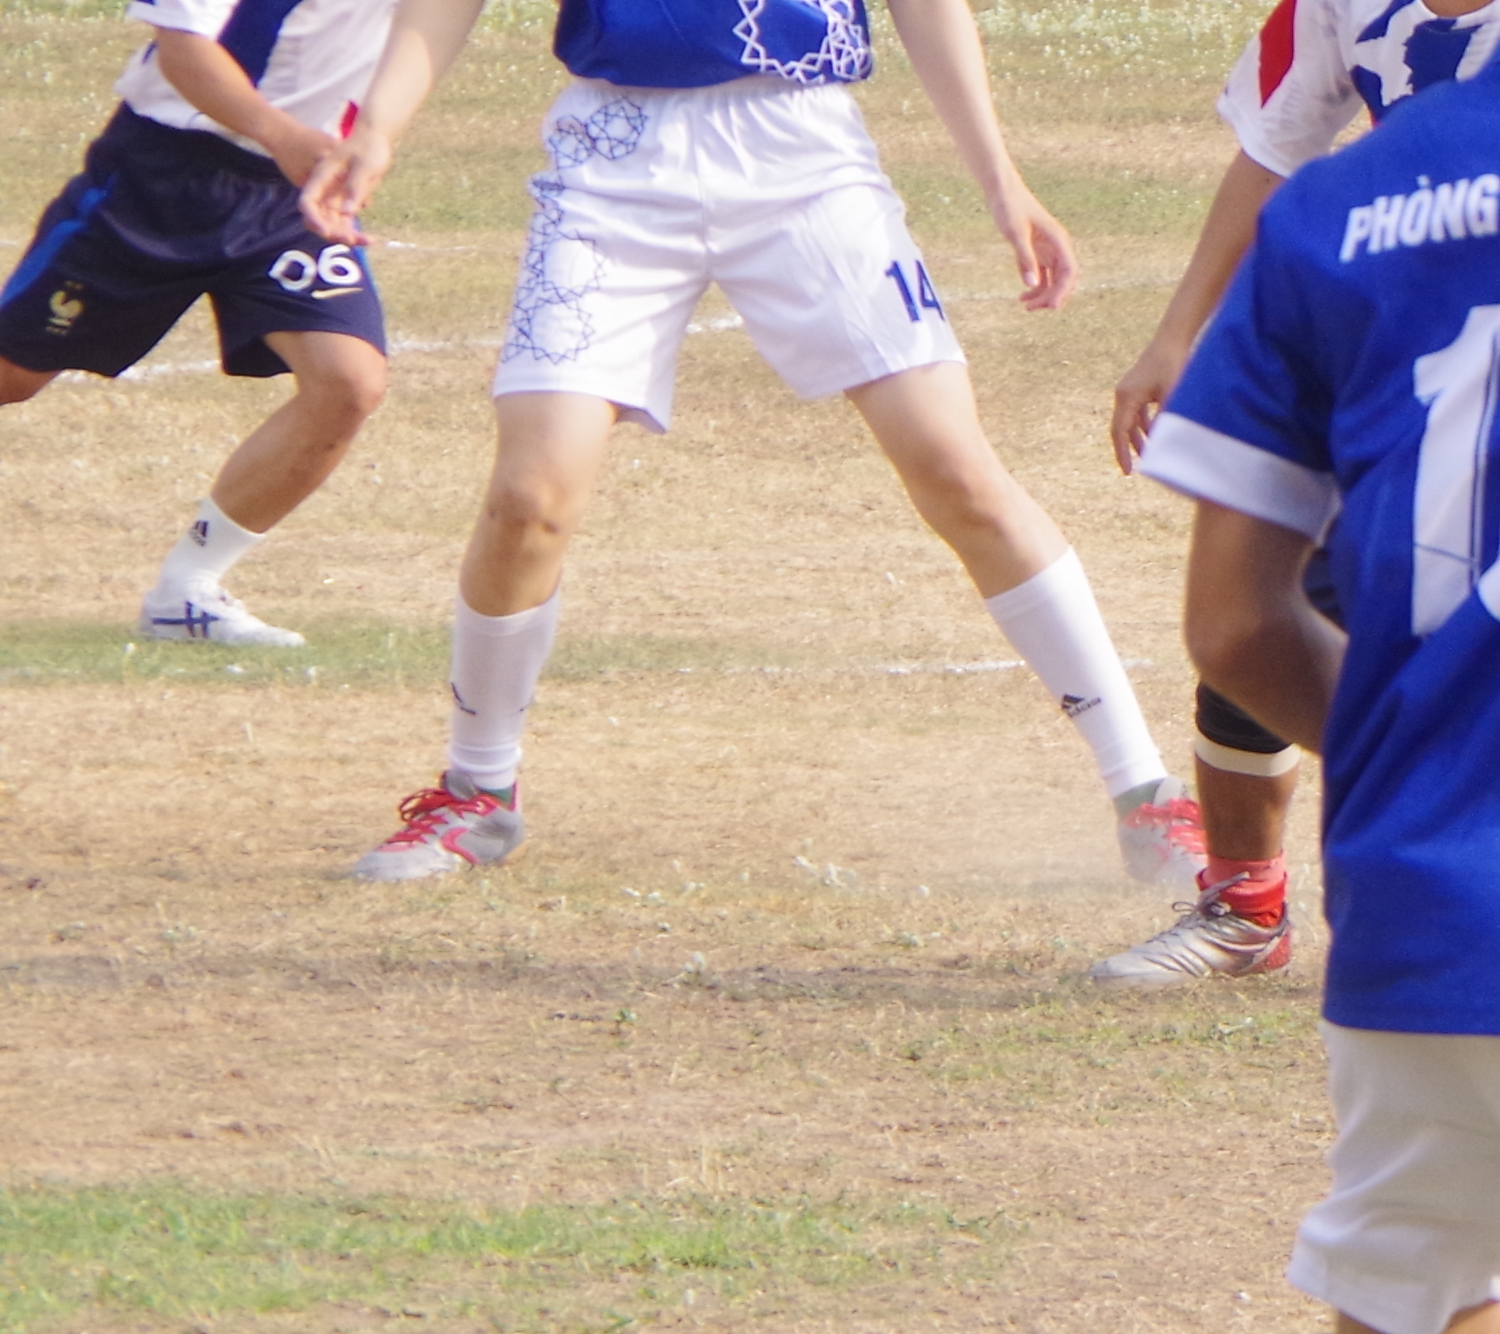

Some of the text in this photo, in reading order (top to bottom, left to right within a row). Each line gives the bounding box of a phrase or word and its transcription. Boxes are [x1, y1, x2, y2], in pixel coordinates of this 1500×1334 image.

[1338, 174, 1500, 263] PHÒNG
[267, 243, 363, 292] 06
[883, 259, 947, 323] 14
